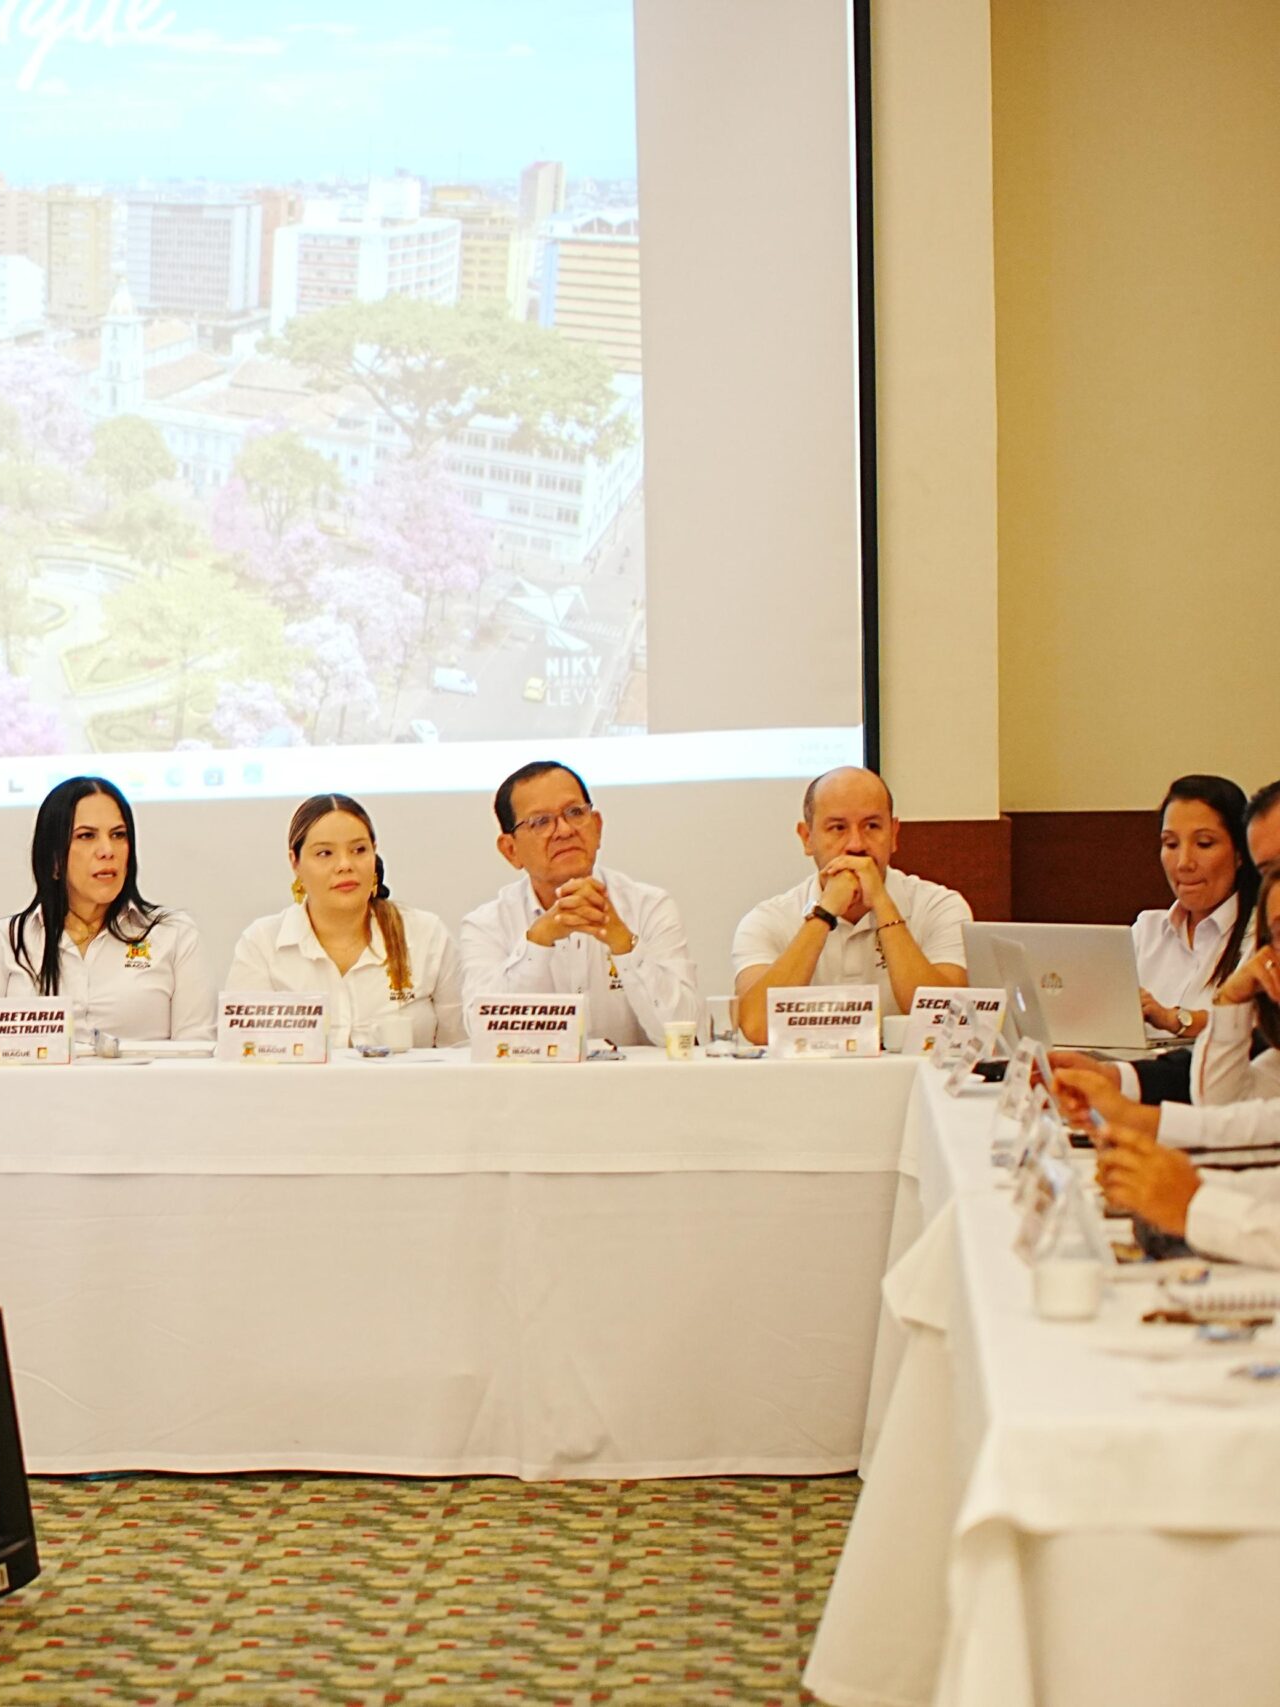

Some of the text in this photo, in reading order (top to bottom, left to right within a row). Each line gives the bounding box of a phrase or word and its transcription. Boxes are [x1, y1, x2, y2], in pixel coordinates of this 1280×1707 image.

[546, 656, 602, 676] NIKY
[546, 687, 602, 707] LEVY
[775, 1001, 873, 1013] SECRETARIA
[916, 998, 1000, 1011] SECRRIA
[224, 1005, 323, 1016] SECRETARIA
[479, 1005, 576, 1016] SECRETARIA
[487, 1020, 567, 1031] HACIENDA
[787, 1015, 862, 1026] GOBIERNO
